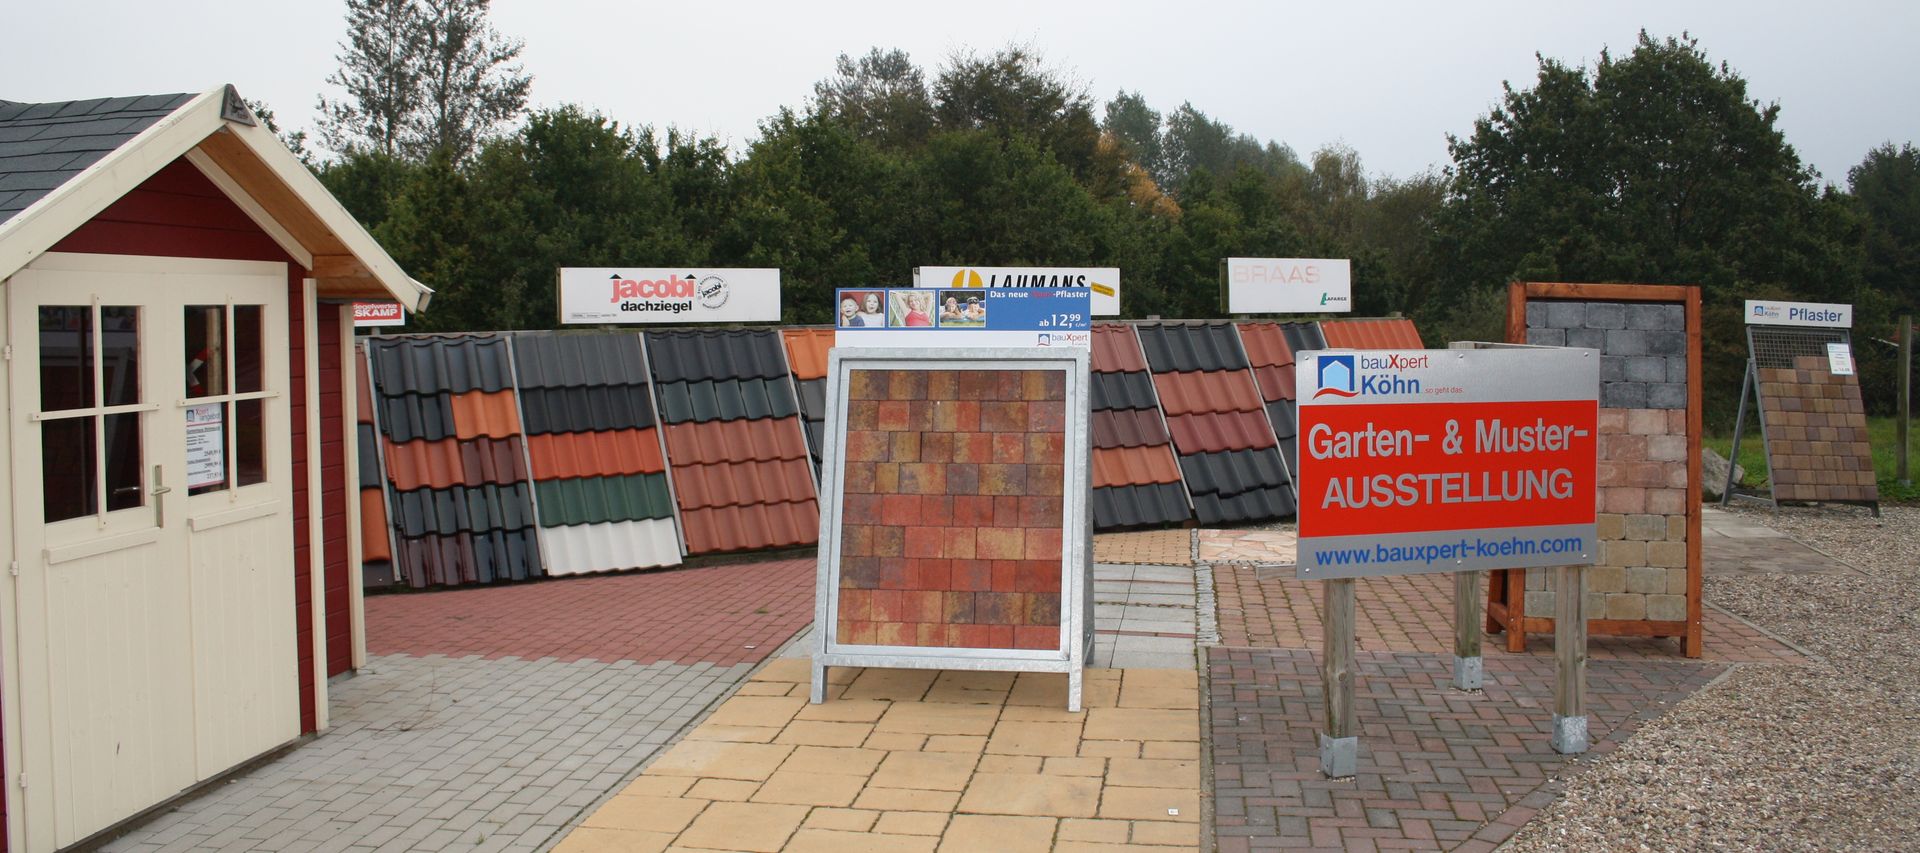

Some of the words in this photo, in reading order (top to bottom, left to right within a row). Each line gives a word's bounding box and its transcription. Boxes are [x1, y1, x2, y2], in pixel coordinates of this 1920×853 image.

[1233, 265, 1320, 283] BRAAS
[610, 274, 695, 303] jacobi
[990, 290, 1006, 298] Das
[621, 300, 692, 313] dachziegel
[1789, 308, 1843, 322] Pflaster
[1039, 319, 1050, 327] ab
[1052, 333, 1088, 346] bauXpert
[1361, 354, 1429, 373] bauXpert
[1361, 374, 1420, 395] Köhn
[1308, 422, 1430, 460] Garten-
[1442, 419, 1463, 455] &
[1475, 417, 1588, 453] Muster-
[1321, 468, 1573, 509] AUSSTELLUNG
[1315, 536, 1582, 566] www.bauxpert-koehn.com
